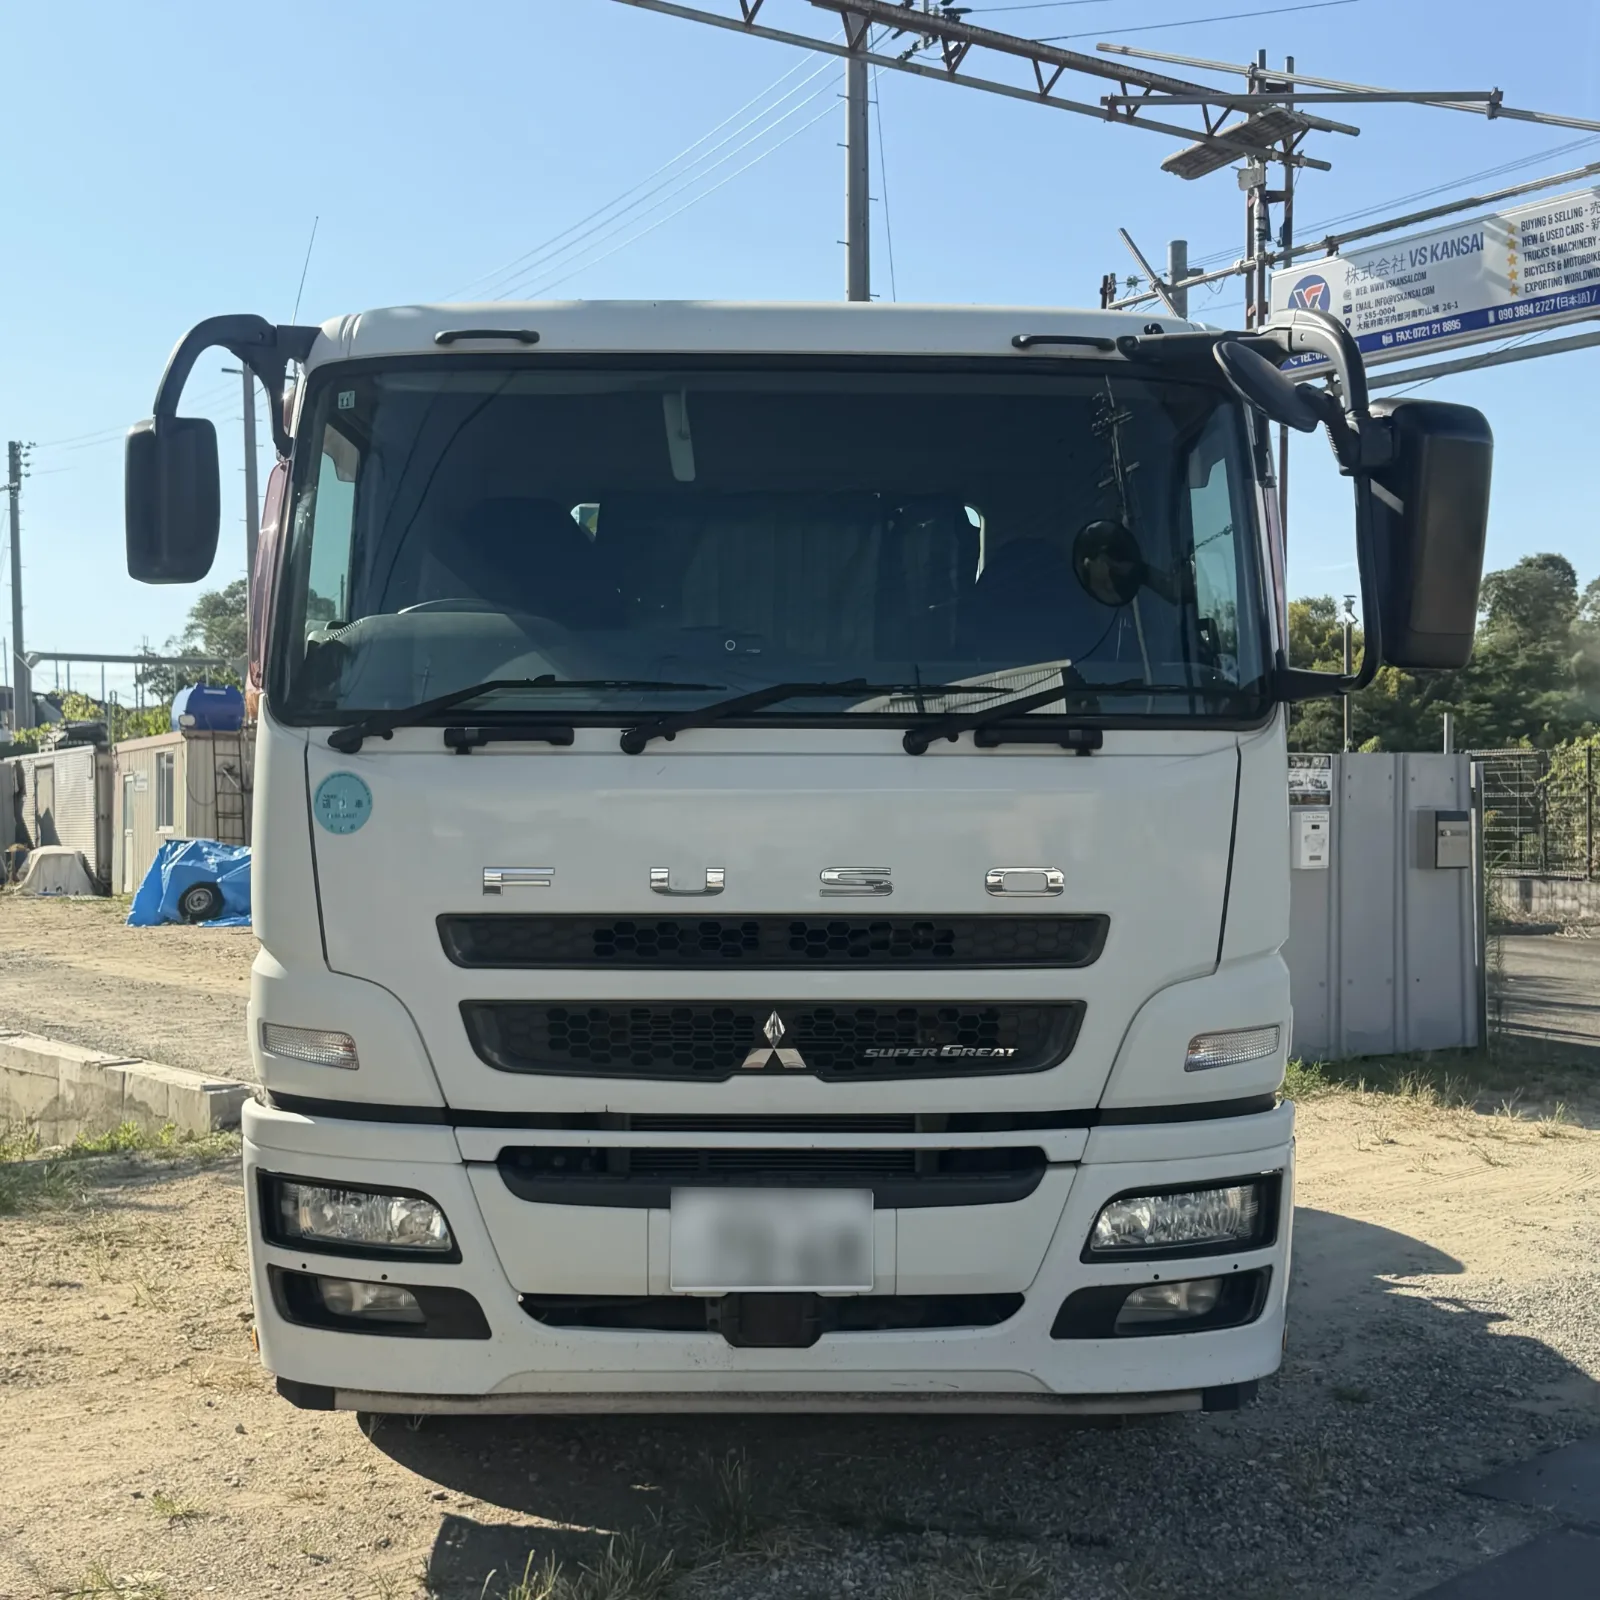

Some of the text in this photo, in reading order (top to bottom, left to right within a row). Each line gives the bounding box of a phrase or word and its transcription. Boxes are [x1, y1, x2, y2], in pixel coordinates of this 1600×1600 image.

[1521, 216, 1546, 232] BUYING
[1547, 214, 1553, 225] &
[1554, 206, 1583, 223] SELLING
[1522, 234, 1538, 247] NEW
[1539, 232, 1545, 243] &
[1546, 227, 1564, 241] USED
[1566, 222, 1584, 236] CARS
[1345, 232, 1484, 286] 株式会社 VS KANSAI
[1523, 247, 1550, 262] TRUCKS
[1551, 245, 1556, 256] &
[1557, 236, 1597, 254] MACHINERY
[1524, 261, 1556, 278] BICYCLES
[1557, 260, 1562, 271] &
[1370, 271, 1427, 293] WWW.VSKANSAI.COM
[1524, 276, 1563, 293] EXPORTING
[1374, 285, 1435, 307] INFO@VSKANSAI.COM
[1442, 301, 1459, 312] 26-1
[1364, 306, 1396, 320] 585-0004
[1498, 308, 1513, 321] 090
[1514, 303, 1534, 318] 3894
[1535, 298, 1555, 313] 2727
[1431, 323, 1441, 336] 21
[483, 867, 1065, 897] FUSO
[863, 1048, 938, 1058] SUPER
